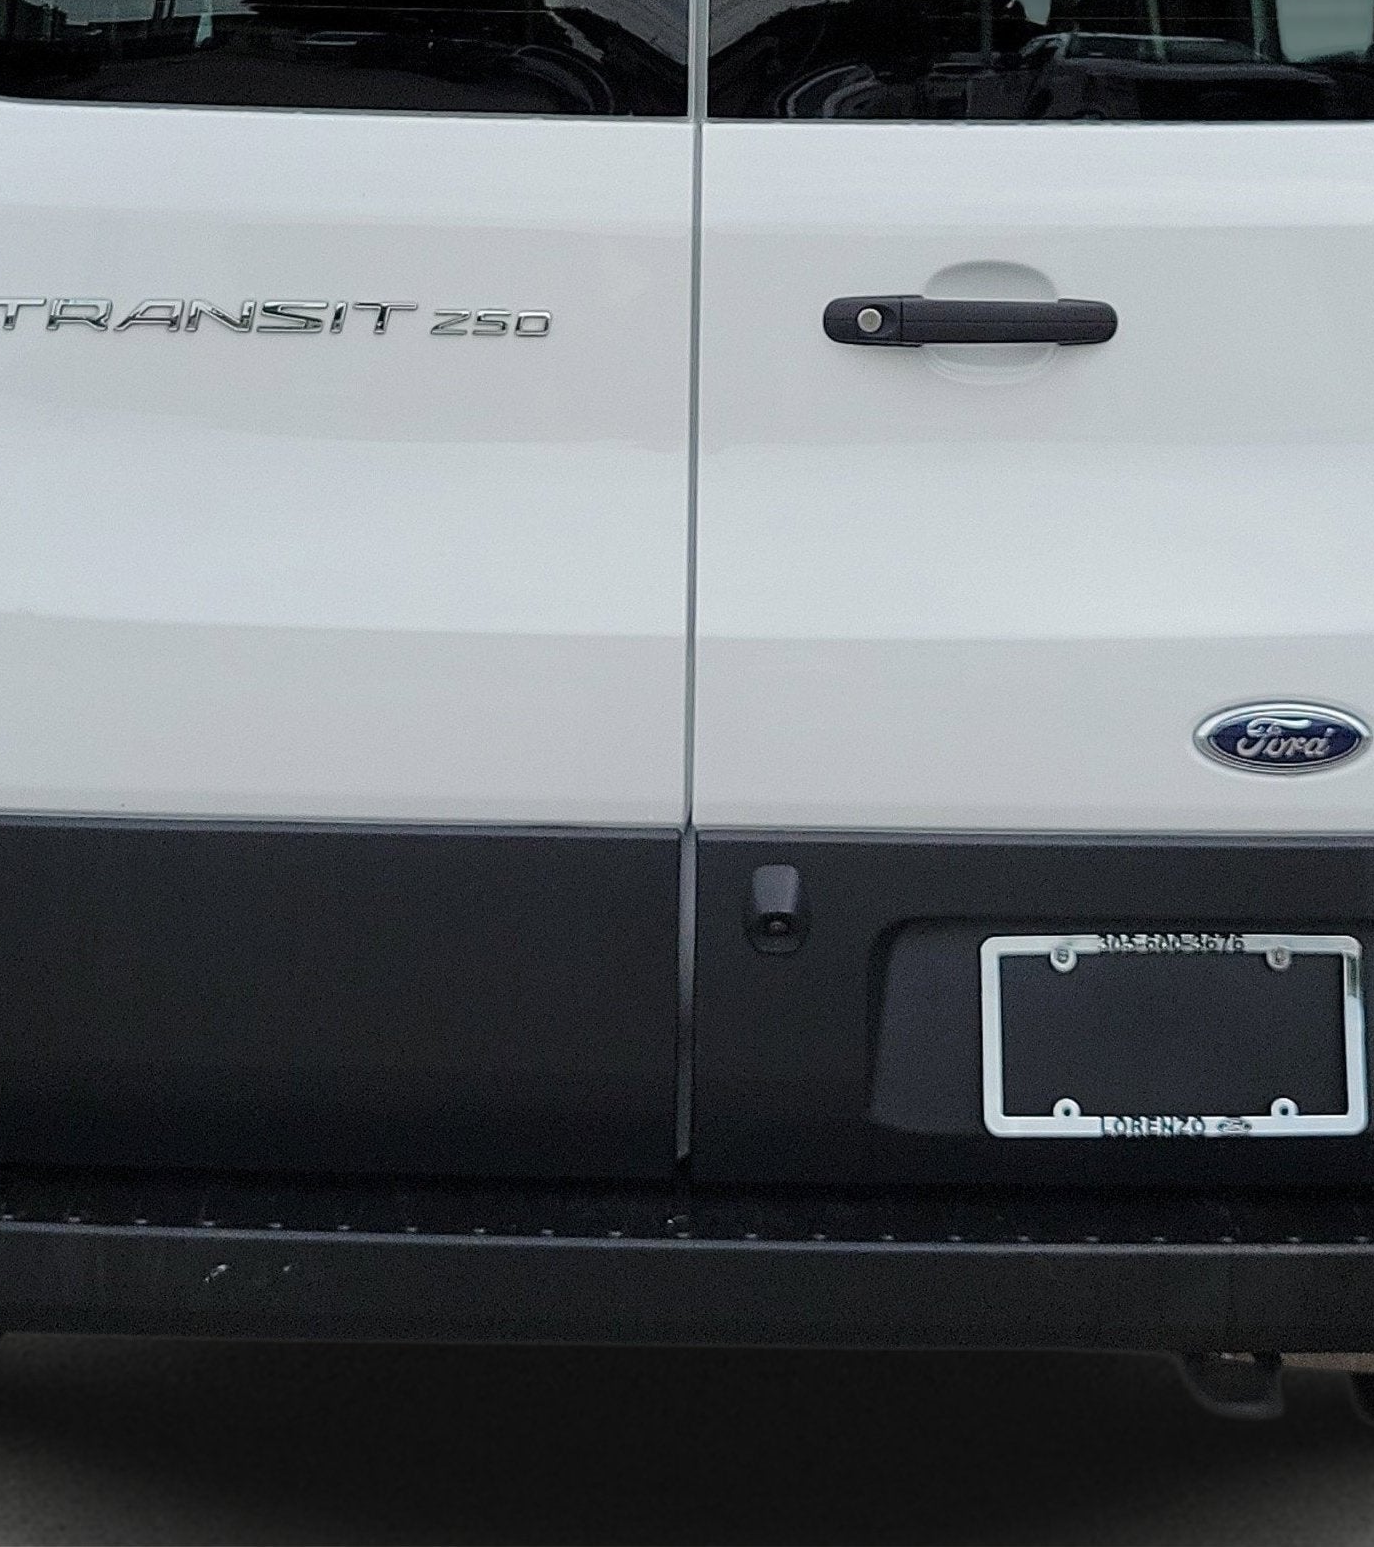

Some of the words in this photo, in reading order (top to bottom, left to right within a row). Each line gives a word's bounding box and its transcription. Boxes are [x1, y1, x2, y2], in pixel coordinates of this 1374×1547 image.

[429, 309, 554, 338] 250
[1236, 717, 1336, 757] Ford
[1100, 1114, 1206, 1138] LORENZO
